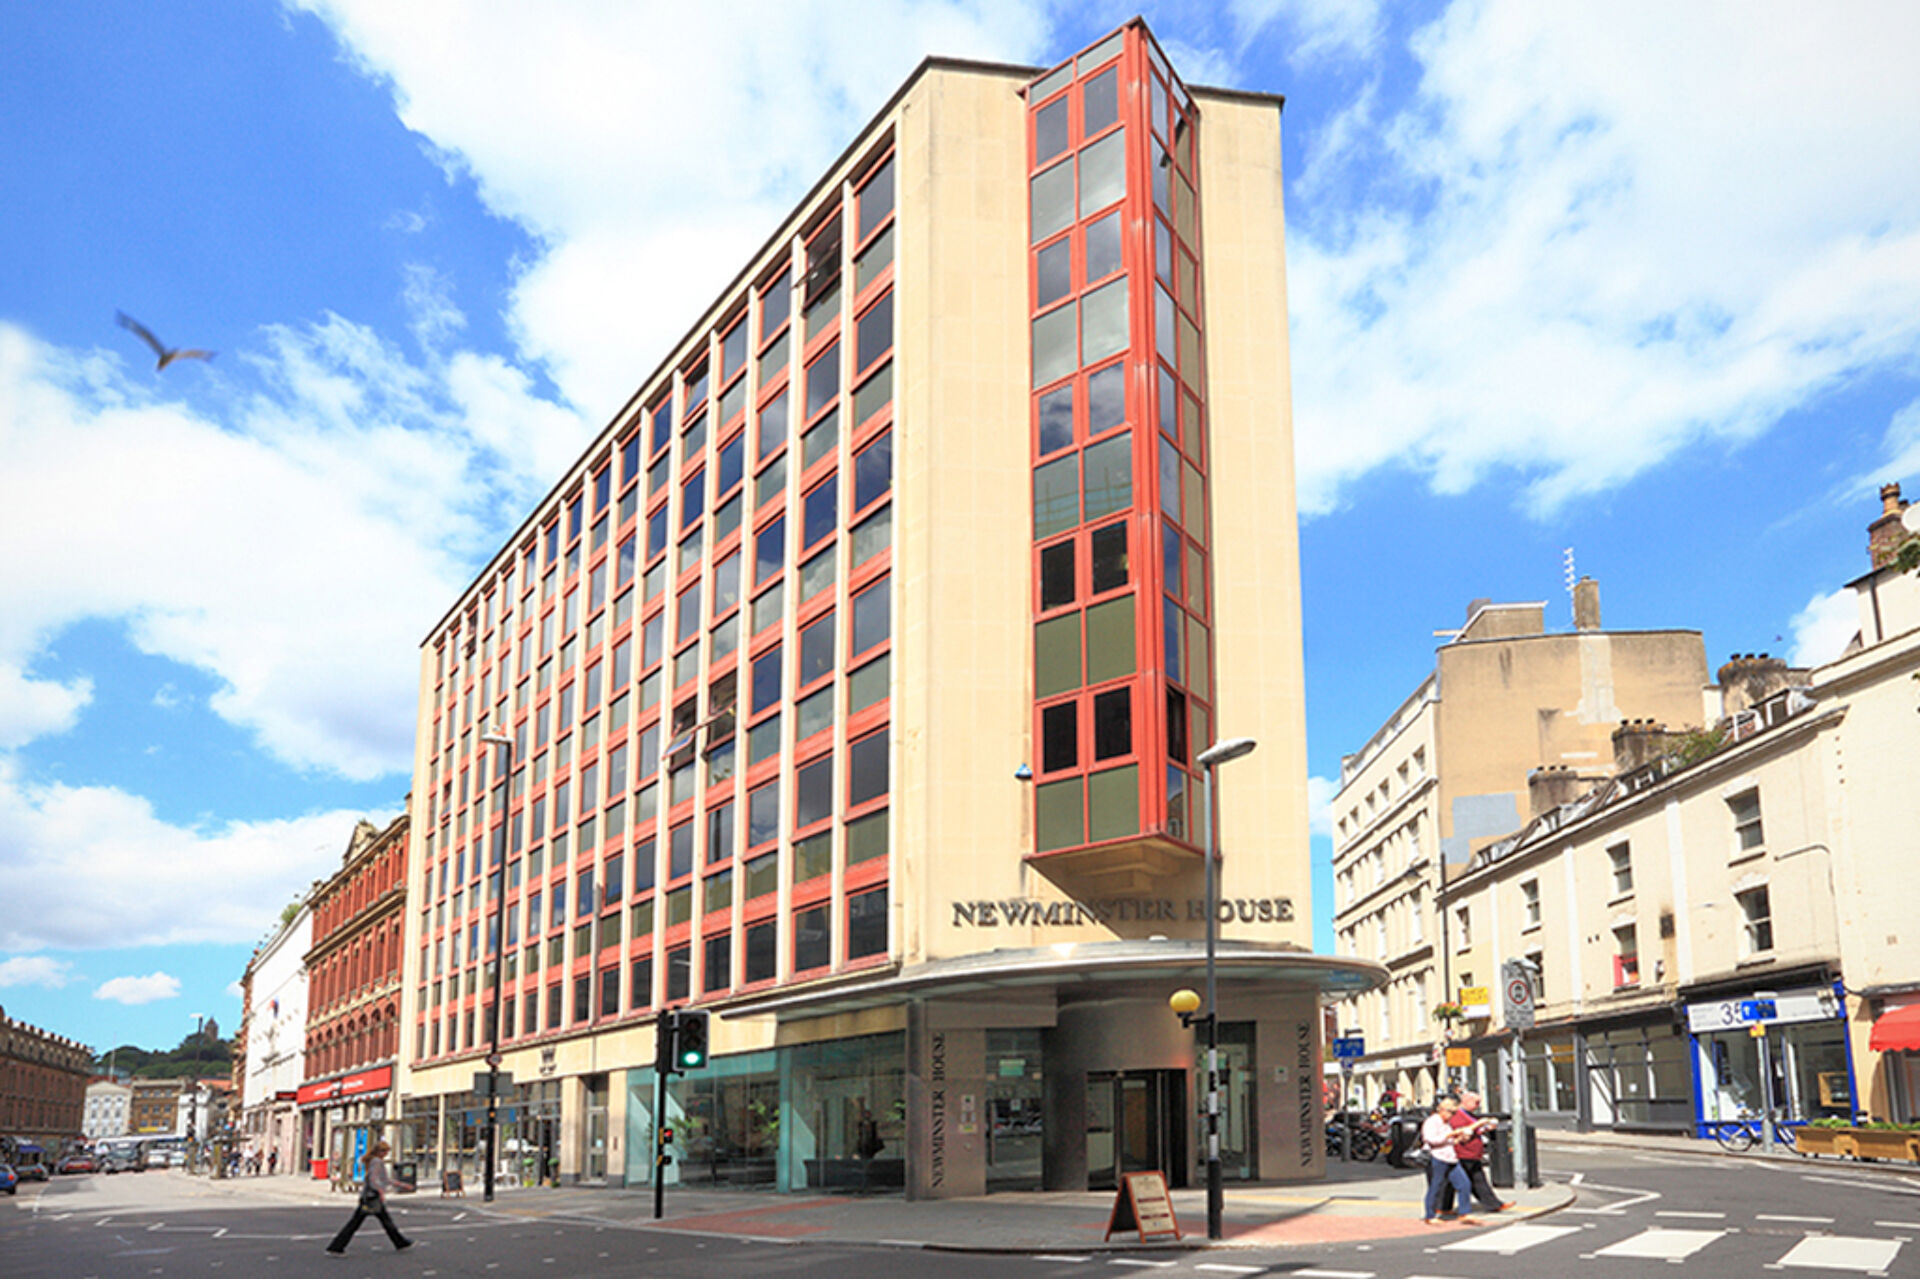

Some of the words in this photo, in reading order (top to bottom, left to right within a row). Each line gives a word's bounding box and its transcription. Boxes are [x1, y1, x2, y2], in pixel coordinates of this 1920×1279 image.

[952, 898, 1175, 927] NEWMINSTER
[1187, 898, 1294, 924] HOUSE
[932, 1032, 945, 1081] HOUSE
[1297, 1022, 1310, 1068] HOUSE
[932, 1091, 945, 1188] NEWMINSTER
[1299, 1075, 1312, 1167] NEWMINSTER
